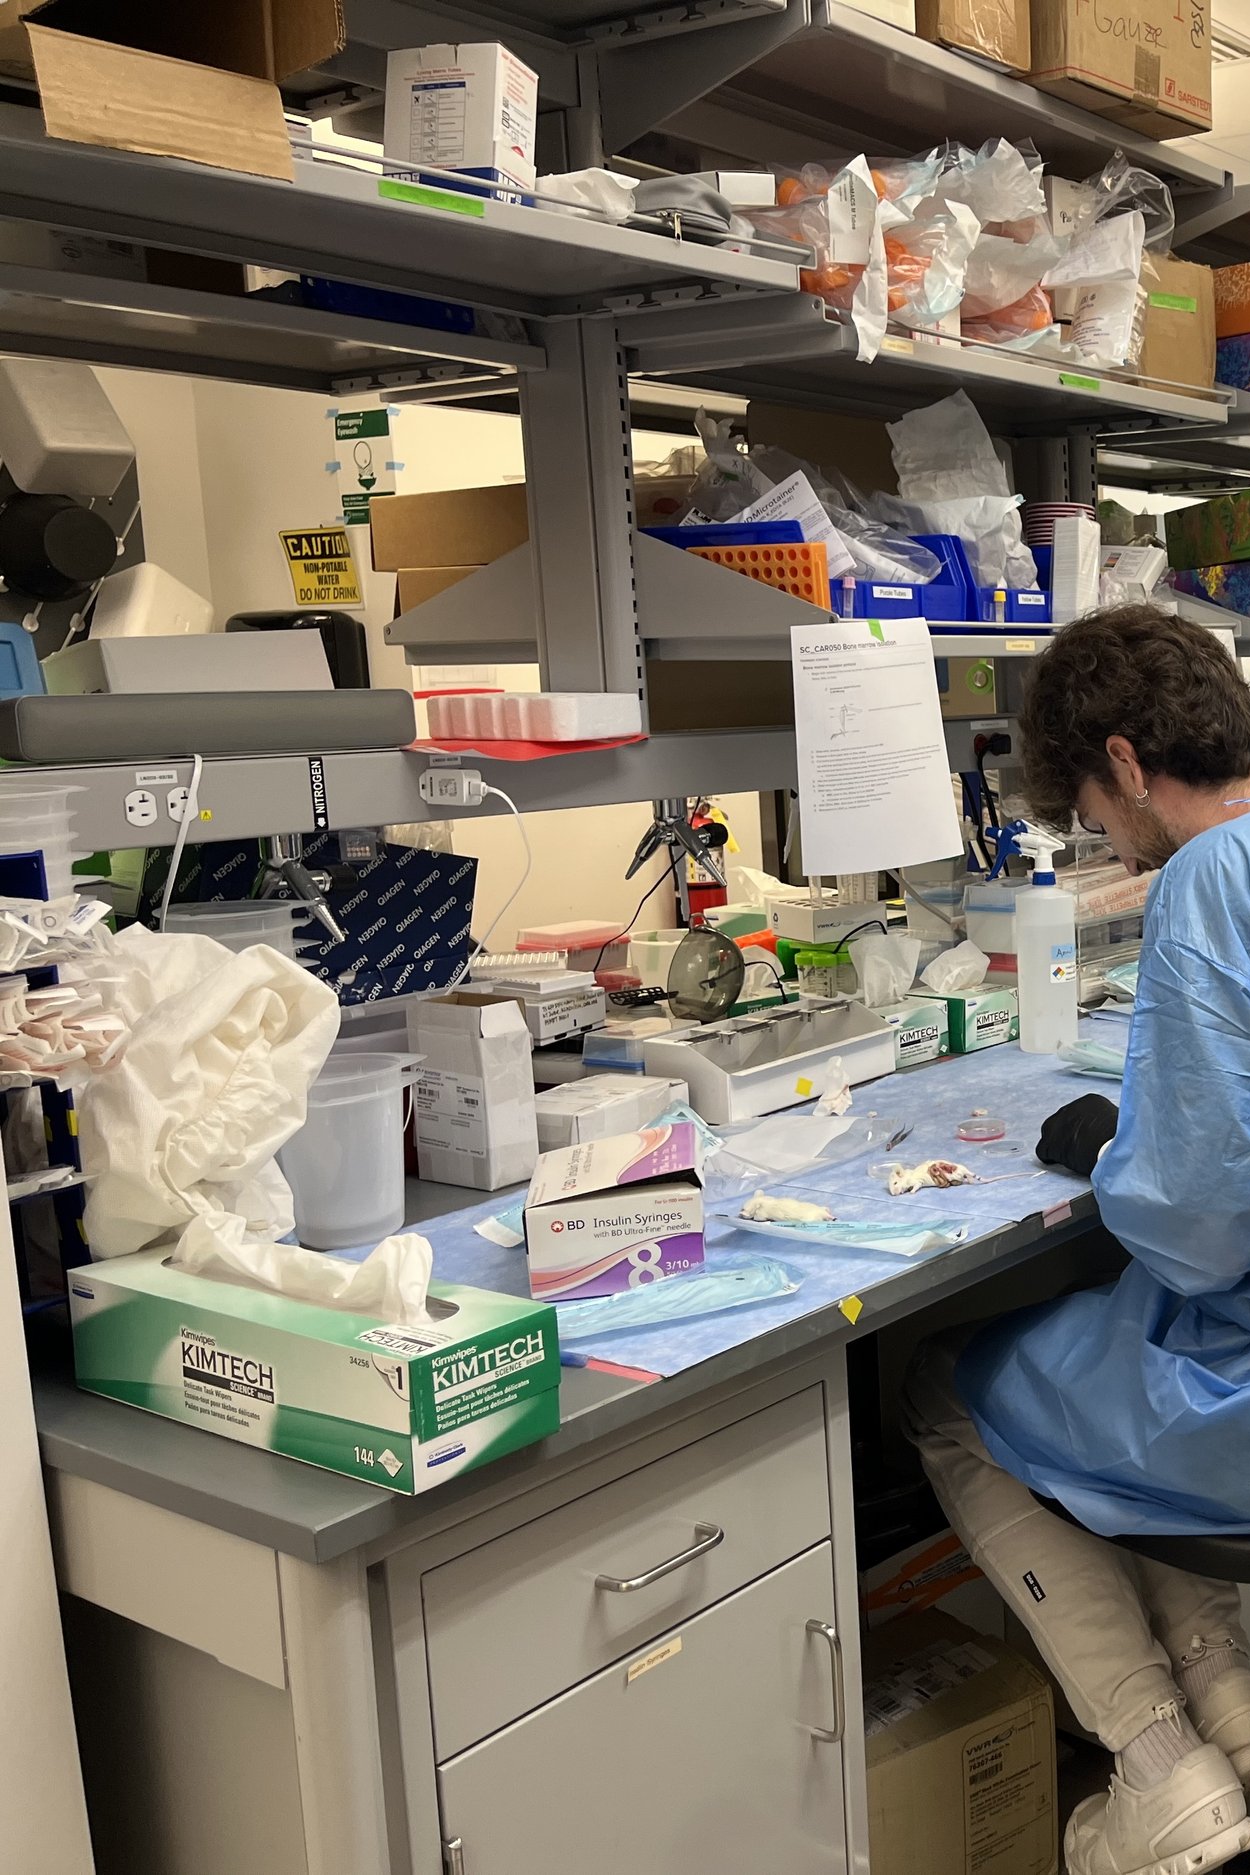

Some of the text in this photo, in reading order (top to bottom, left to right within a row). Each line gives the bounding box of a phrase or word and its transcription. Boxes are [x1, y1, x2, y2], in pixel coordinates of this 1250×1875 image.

[1177, 90, 1212, 113] SARSTEDT
[337, 417, 363, 428] Emergency
[337, 427, 358, 437] Eyewash
[286, 535, 350, 557] CAUTION
[303, 560, 349, 574] NON-POTABLE
[317, 573, 340, 586] WATER
[300, 585, 358, 602] DO NOT DRINK
[800, 643, 842, 655] SC_CAR050
[842, 642, 857, 651] Bone
[310, 760, 326, 814] NITROGEN
[976, 1010, 1010, 1026] KIMTECH
[900, 1026, 939, 1044] KIMTECH
[567, 1211, 683, 1230] BD Insulin Syringes
[594, 1230, 610, 1239] with
[611, 1228, 623, 1237] BD
[666, 1222, 691, 1232] needle
[627, 1242, 665, 1289] 8
[665, 1259, 689, 1270] 3/10
[181, 1327, 216, 1347] Kimwipes
[181, 1341, 274, 1390] KIMTECH
[349, 1356, 370, 1369] 34256
[432, 1329, 544, 1392] KIMTECH
[526, 1354, 542, 1366] BRAND
[395, 1366, 403, 1390] 1
[183, 1379, 232, 1401] Delicate Task Wipers
[184, 1390, 210, 1404] Essuie-tout
[210, 1399, 221, 1409] pour
[435, 1383, 498, 1413] Delicate Task Wipers
[199, 1406, 211, 1415] para
[211, 1410, 226, 1421] tareas
[226, 1414, 250, 1428] delicadas
[436, 1405, 470, 1422] Essuie-tout
[470, 1398, 484, 1409] pour
[456, 1413, 471, 1424] para
[471, 1404, 490, 1417] tareas
[490, 1393, 518, 1409] delicadas
[354, 1446, 375, 1467] 144
[646, 1648, 671, 1666] Syringes
[966, 1740, 992, 1756] VWR
